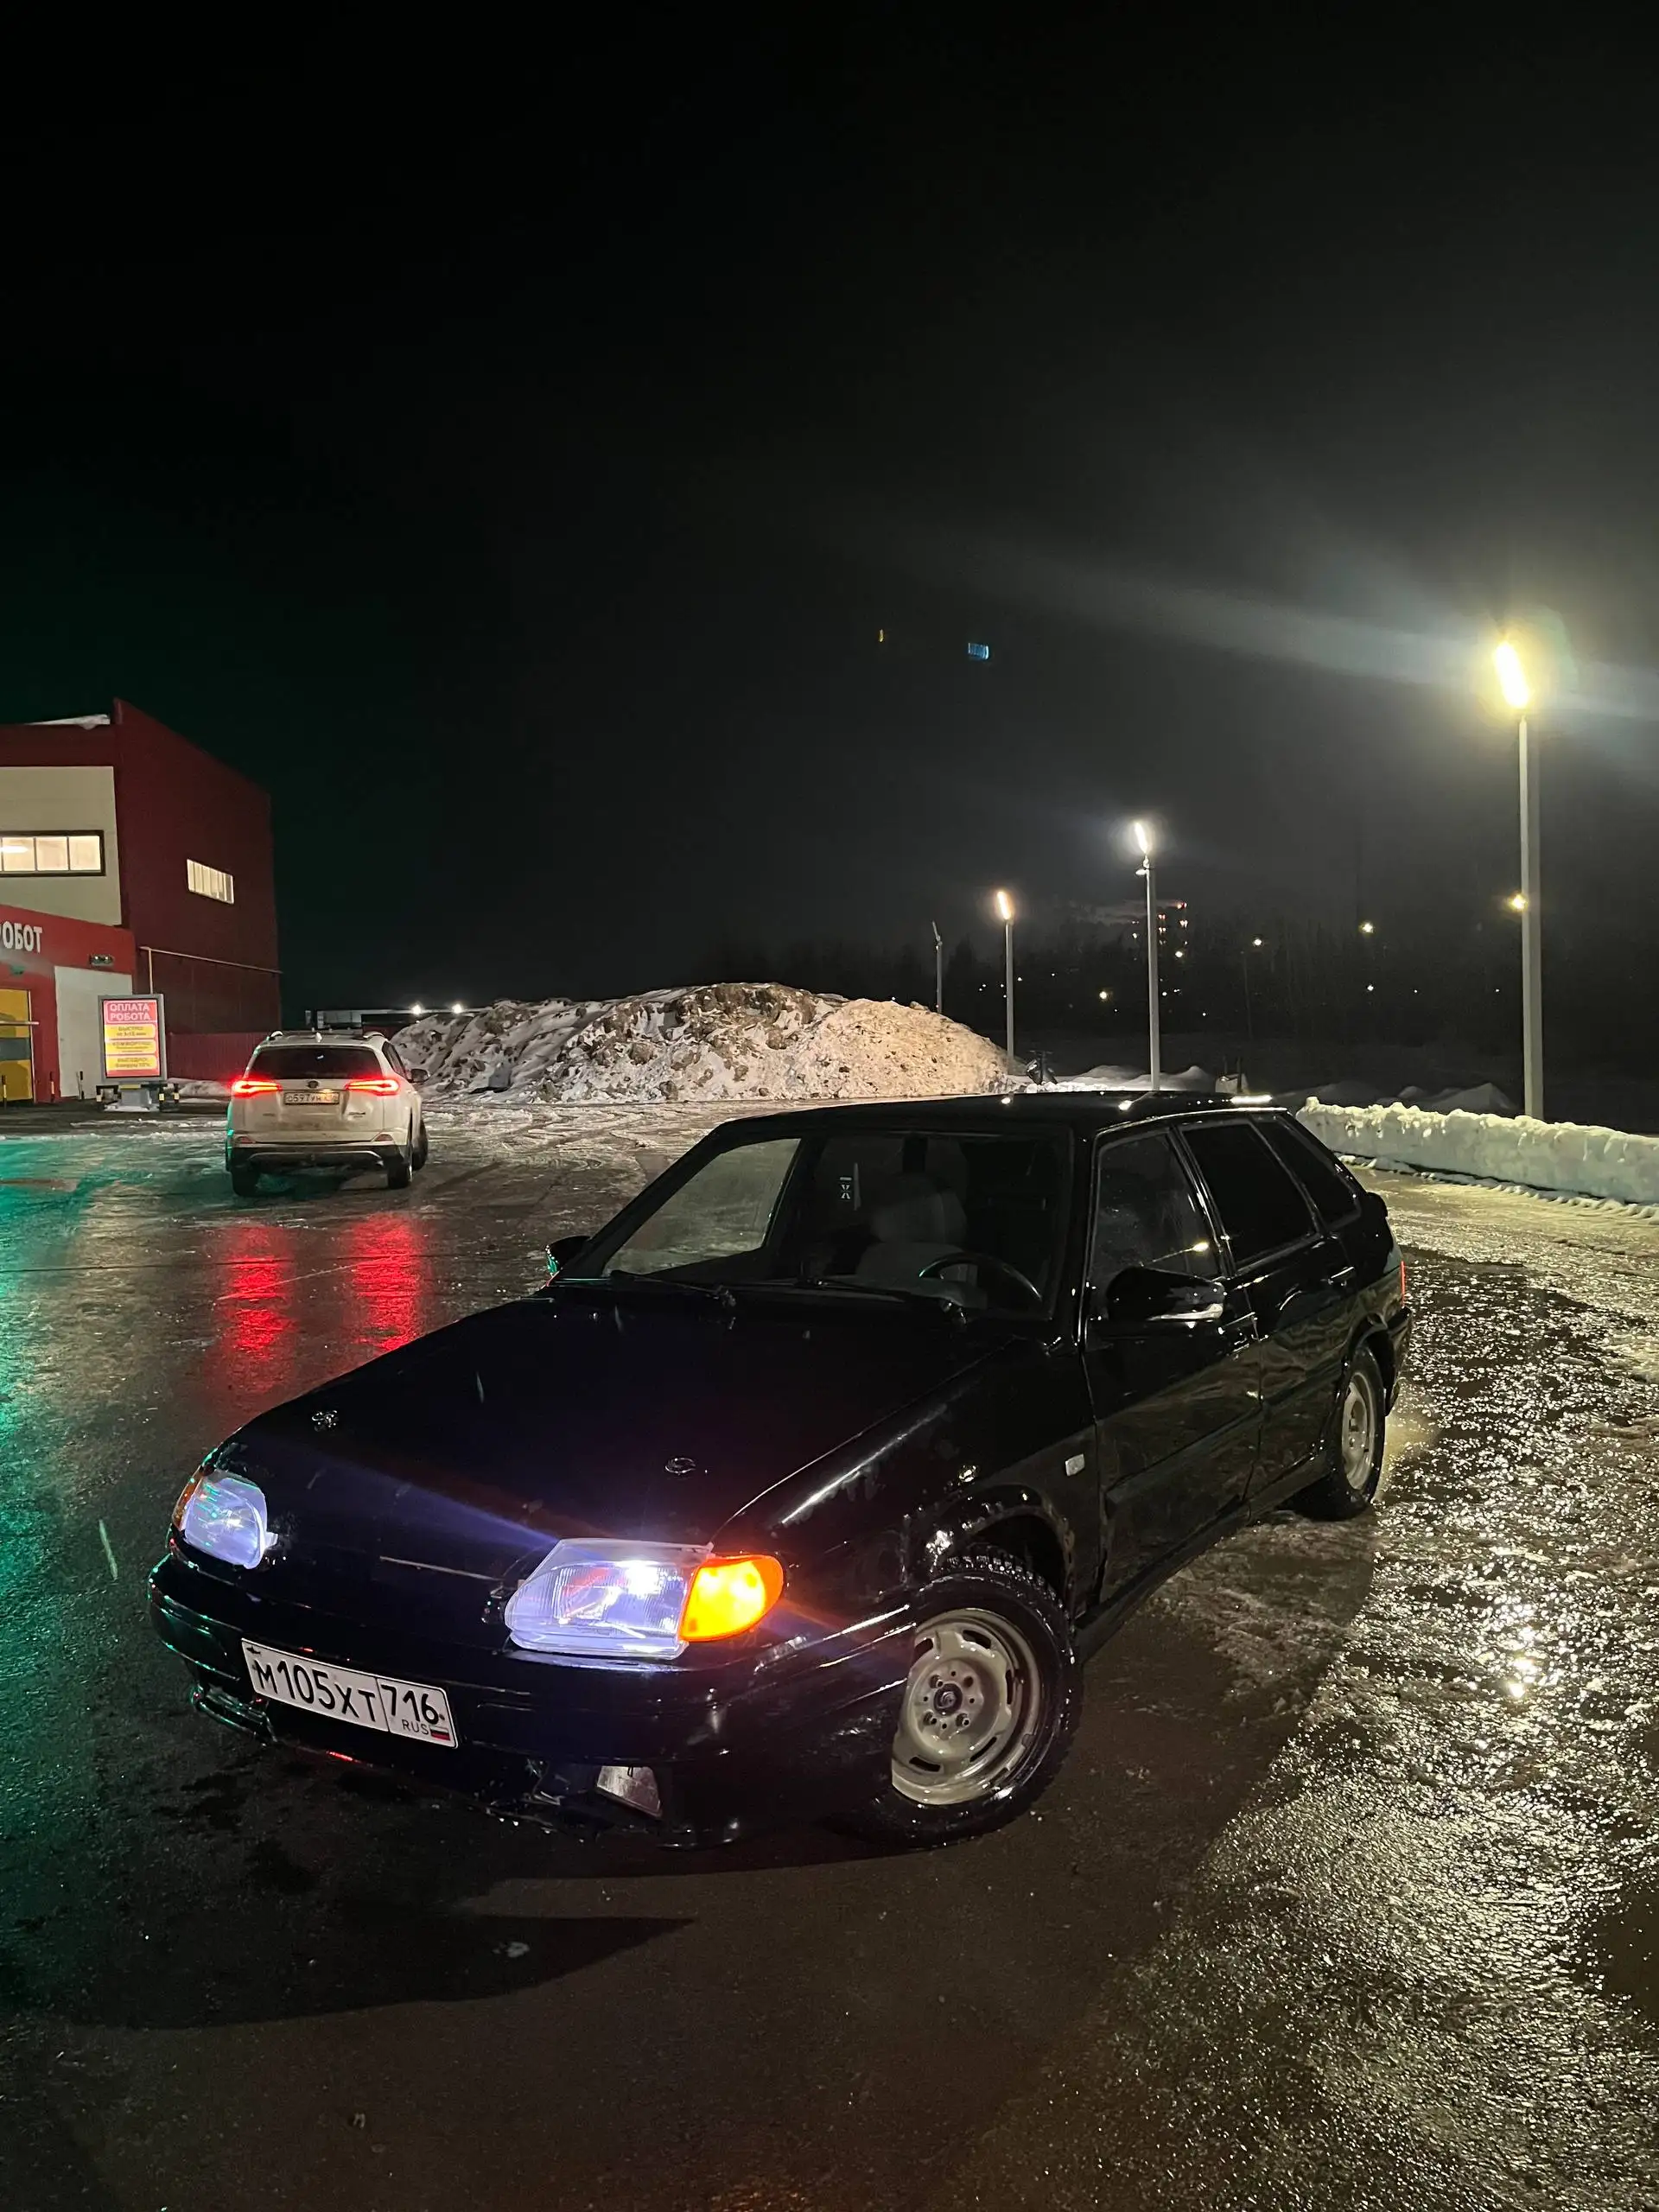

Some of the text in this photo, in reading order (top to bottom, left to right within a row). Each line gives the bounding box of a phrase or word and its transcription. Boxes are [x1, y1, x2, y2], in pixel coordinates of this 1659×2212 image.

[0, 920, 42, 953] ОБОТ
[253, 1659, 439, 1725] М105ХТ 716
[401, 1719, 429, 1735] RUS
